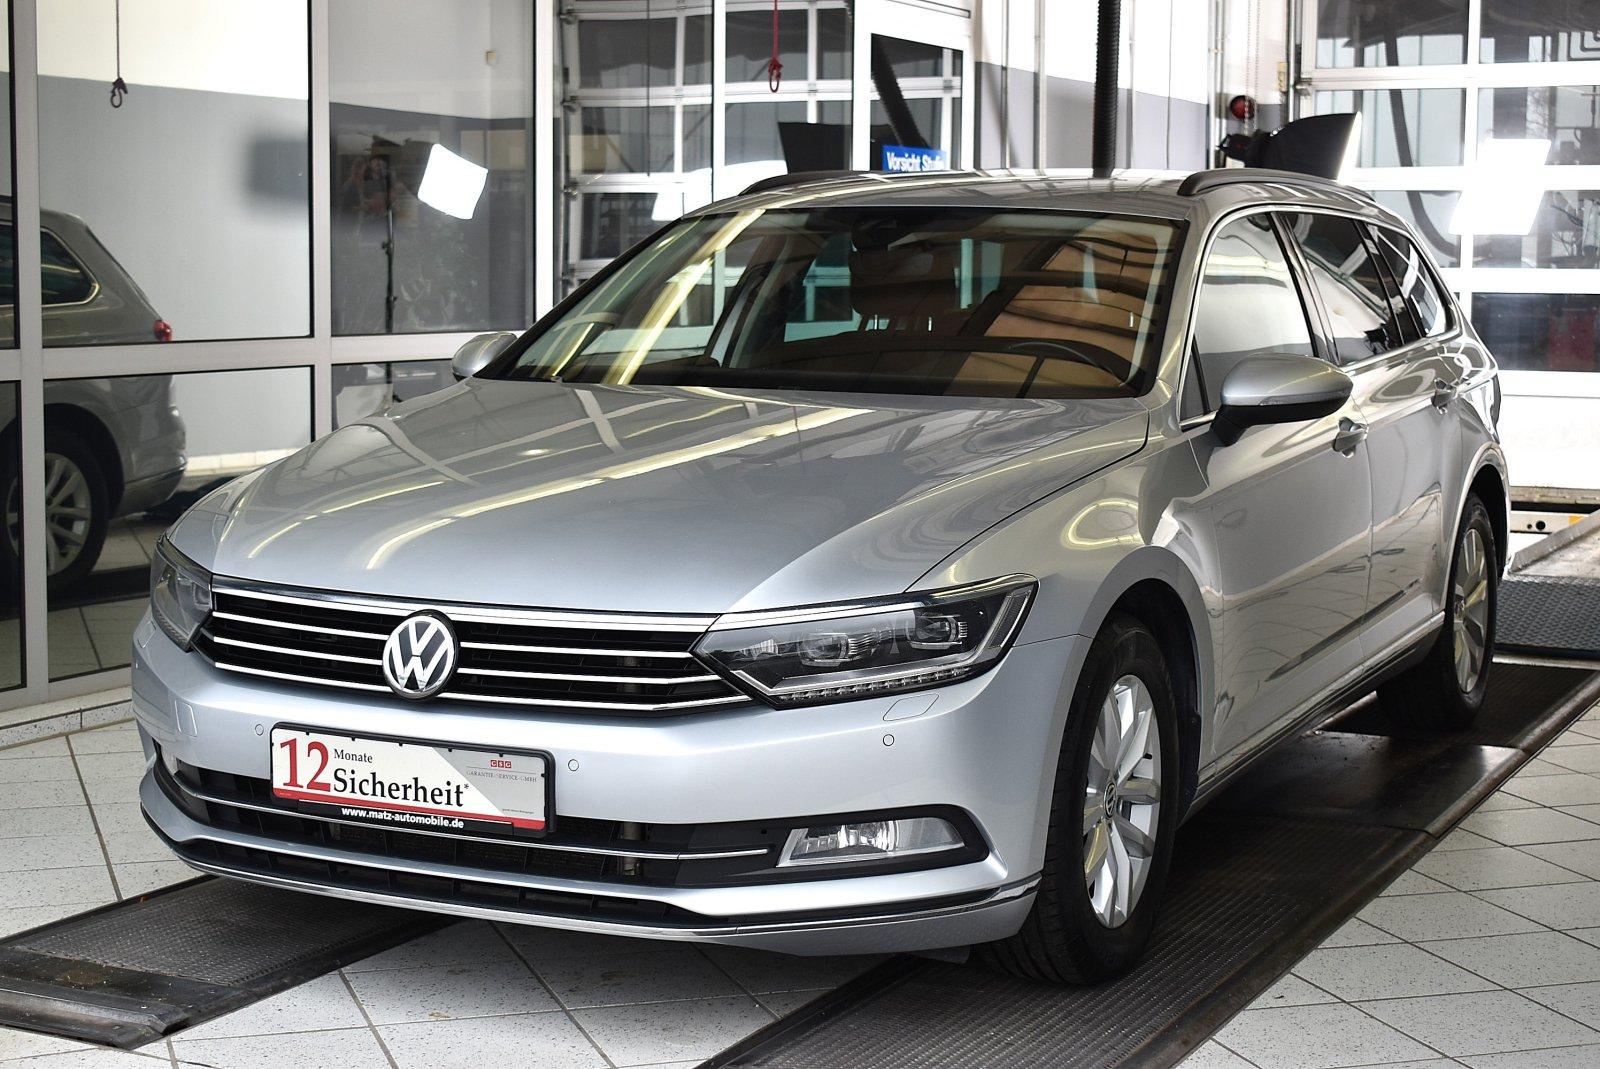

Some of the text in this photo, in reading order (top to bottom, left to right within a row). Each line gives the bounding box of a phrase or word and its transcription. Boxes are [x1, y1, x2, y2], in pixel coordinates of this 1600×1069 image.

[886, 151, 921, 172] Vorsicht
[384, 617, 453, 695] VW
[279, 737, 331, 793] 12
[334, 748, 373, 764] Monate
[341, 807, 464, 829] www.matz-automobile.de
